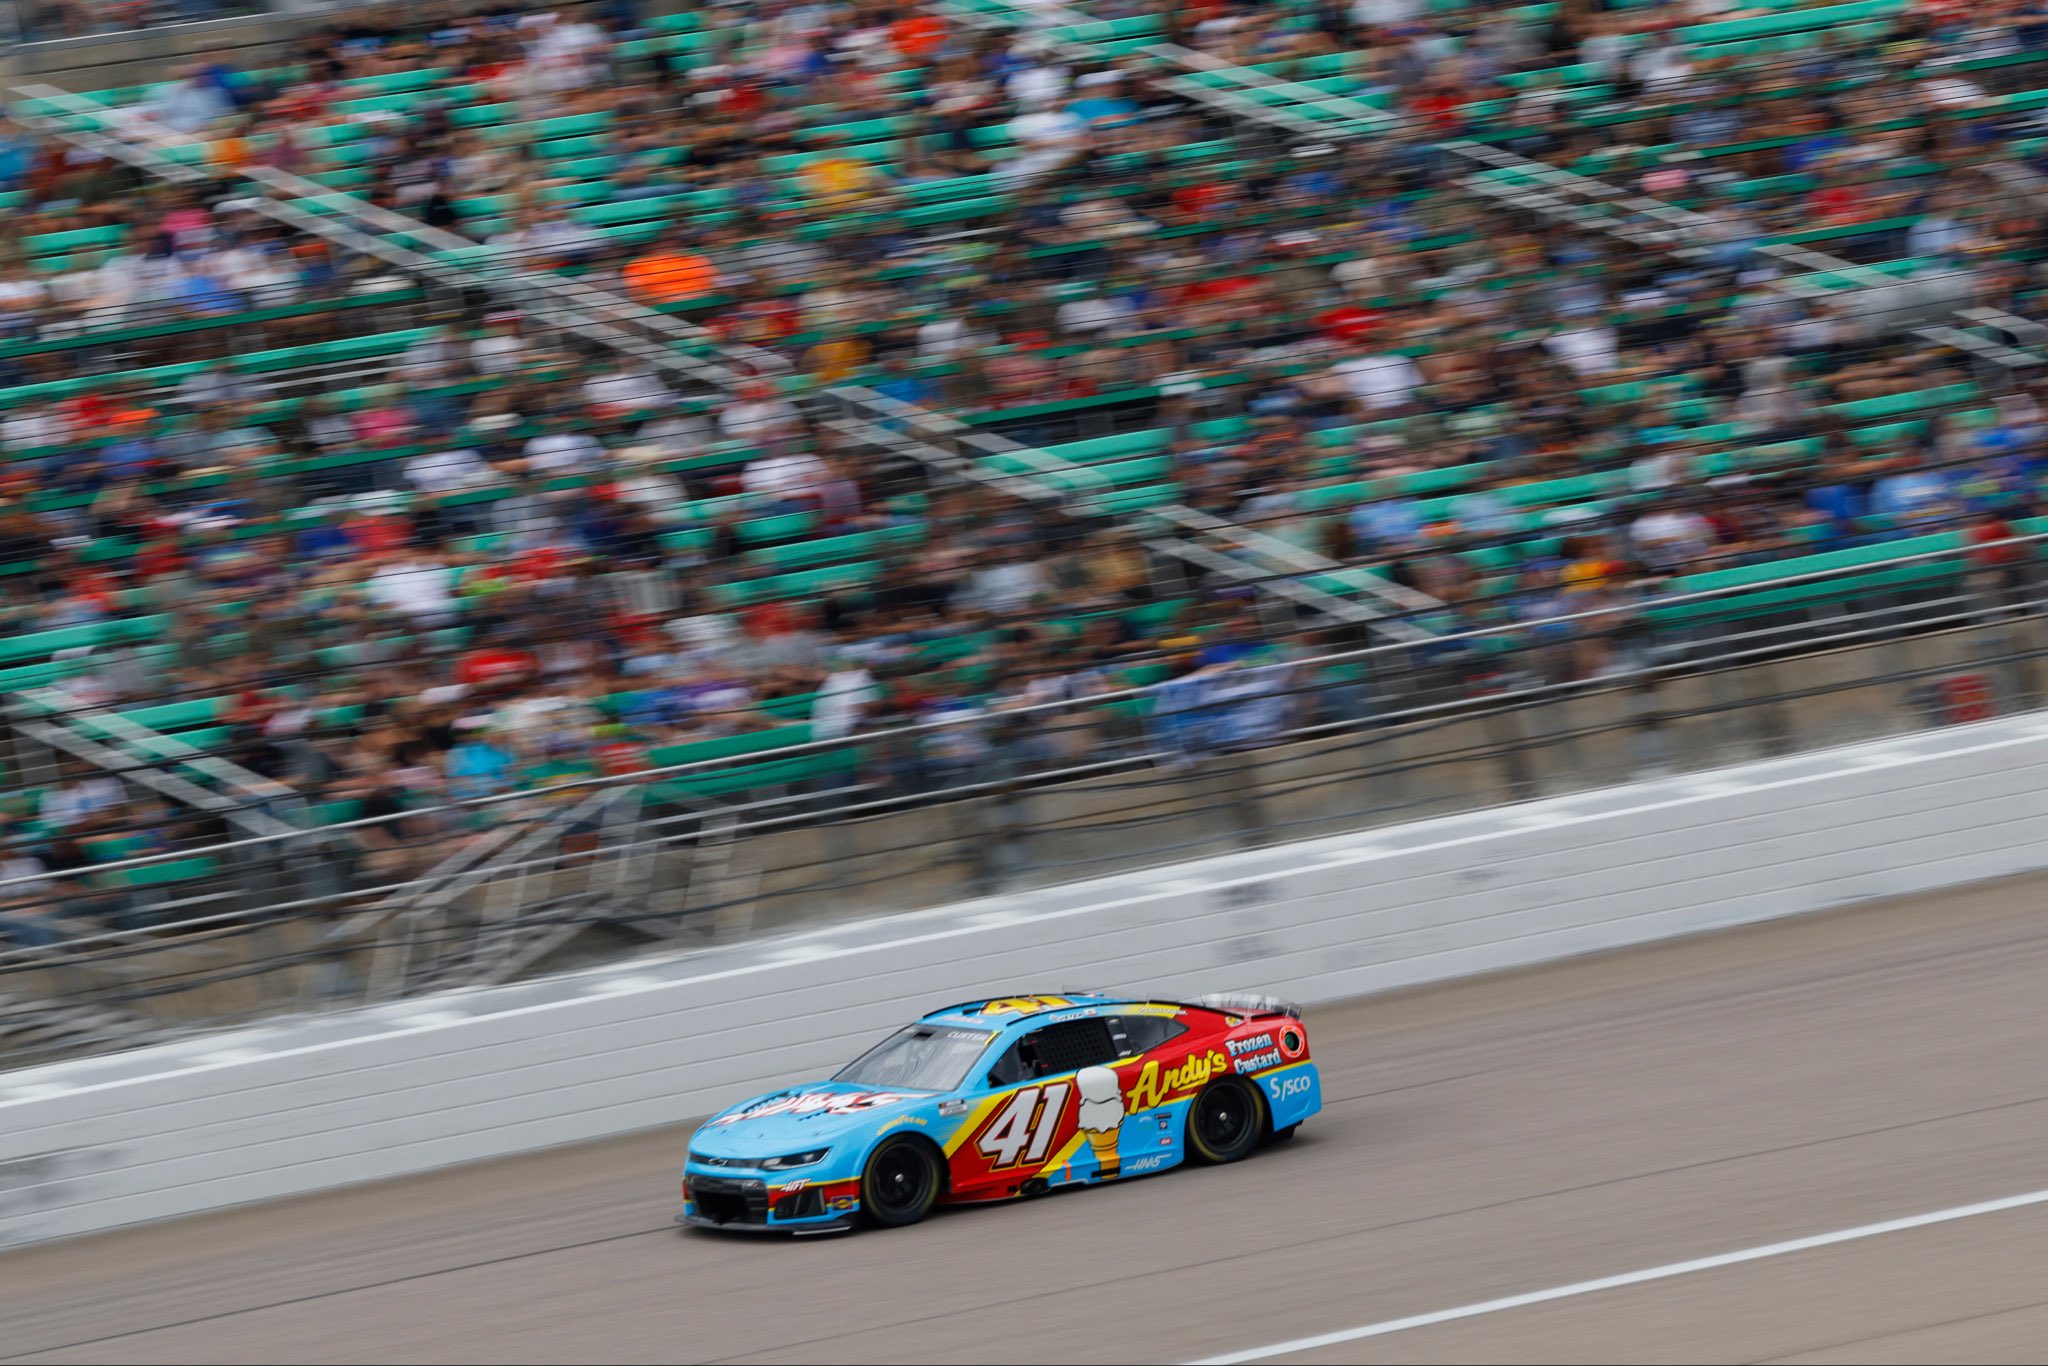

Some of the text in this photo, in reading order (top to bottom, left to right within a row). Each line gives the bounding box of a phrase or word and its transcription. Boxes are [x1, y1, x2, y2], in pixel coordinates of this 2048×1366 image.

[1225, 1033, 1273, 1058] Frozen
[1233, 1048, 1283, 1075] Custard
[1126, 1049, 1228, 1115] Andy's
[1270, 1075, 1311, 1101] Sysco
[976, 1081, 1072, 1170] 41
